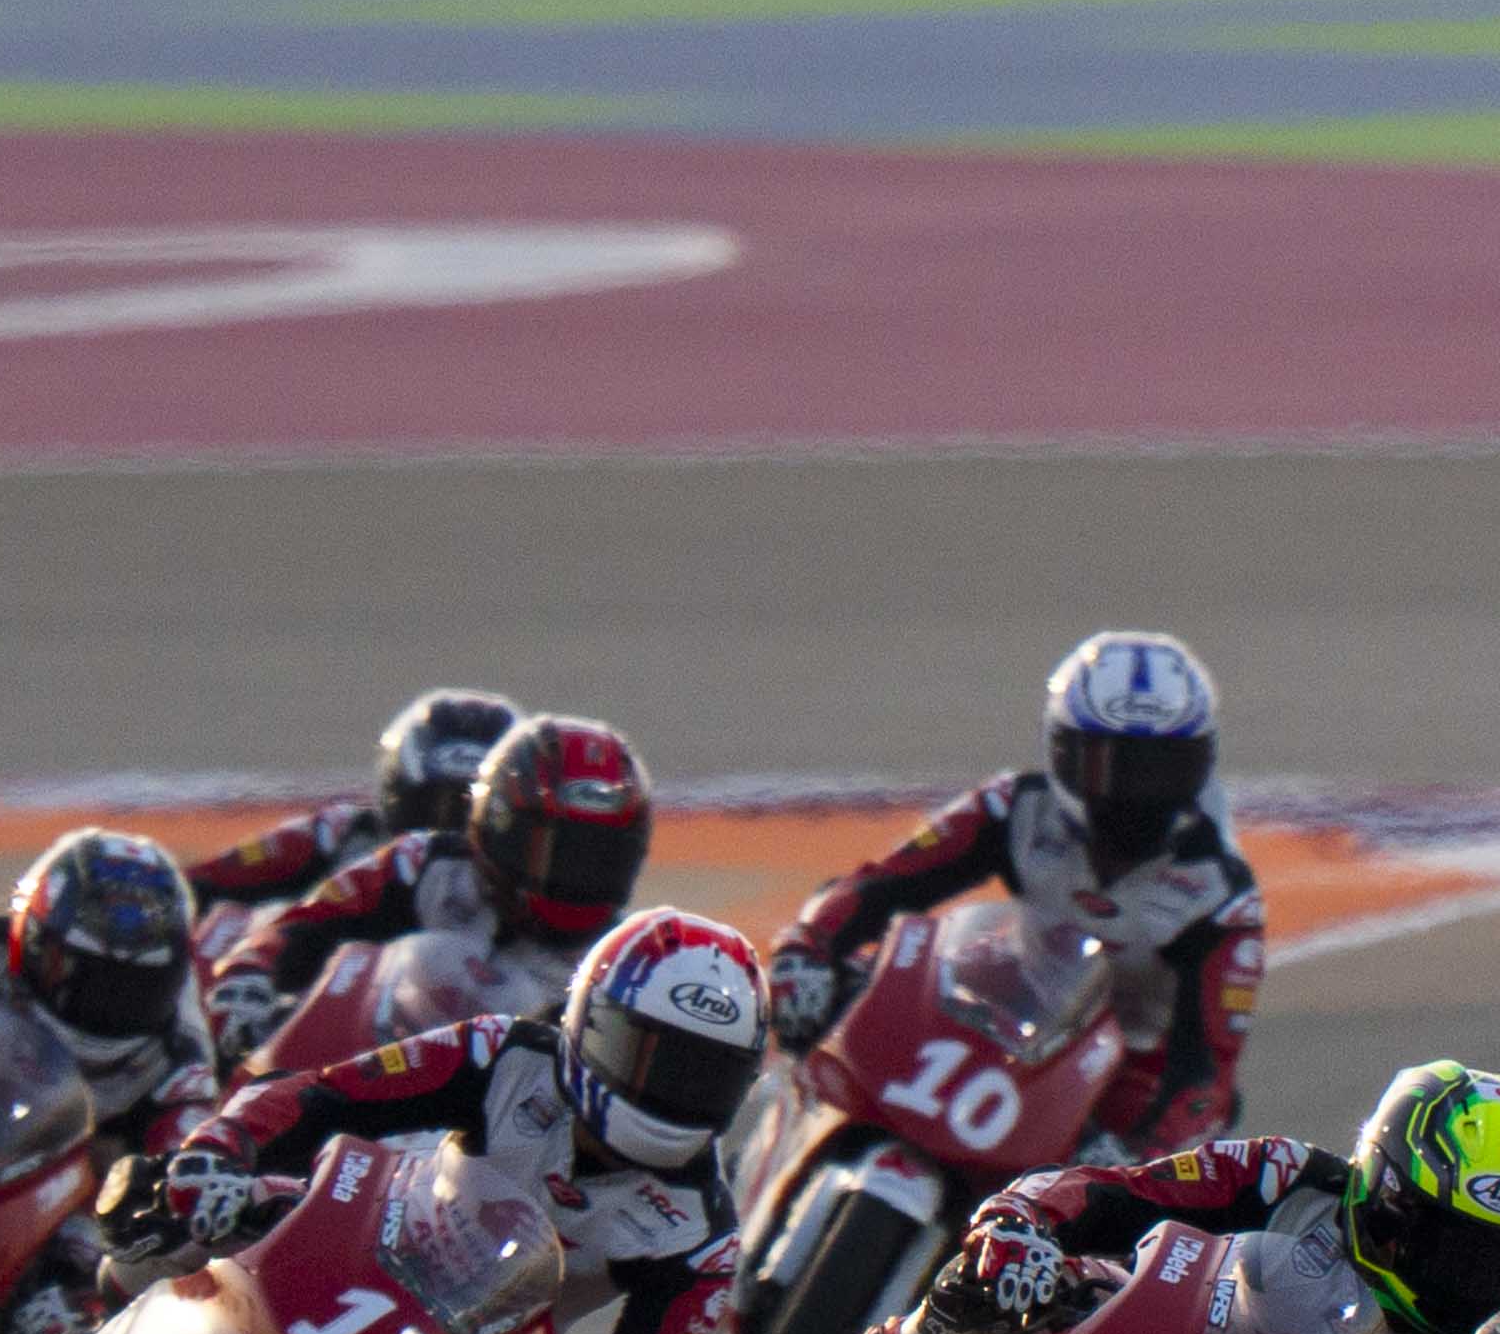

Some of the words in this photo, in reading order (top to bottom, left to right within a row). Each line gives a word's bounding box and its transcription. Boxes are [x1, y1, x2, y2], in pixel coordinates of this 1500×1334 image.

[680, 987, 733, 1018] Arai
[880, 1039, 1021, 1152] 10
[637, 1184, 689, 1227] HRC
[1159, 1239, 1202, 1284] Beta
[1211, 1279, 1237, 1328] WRS
